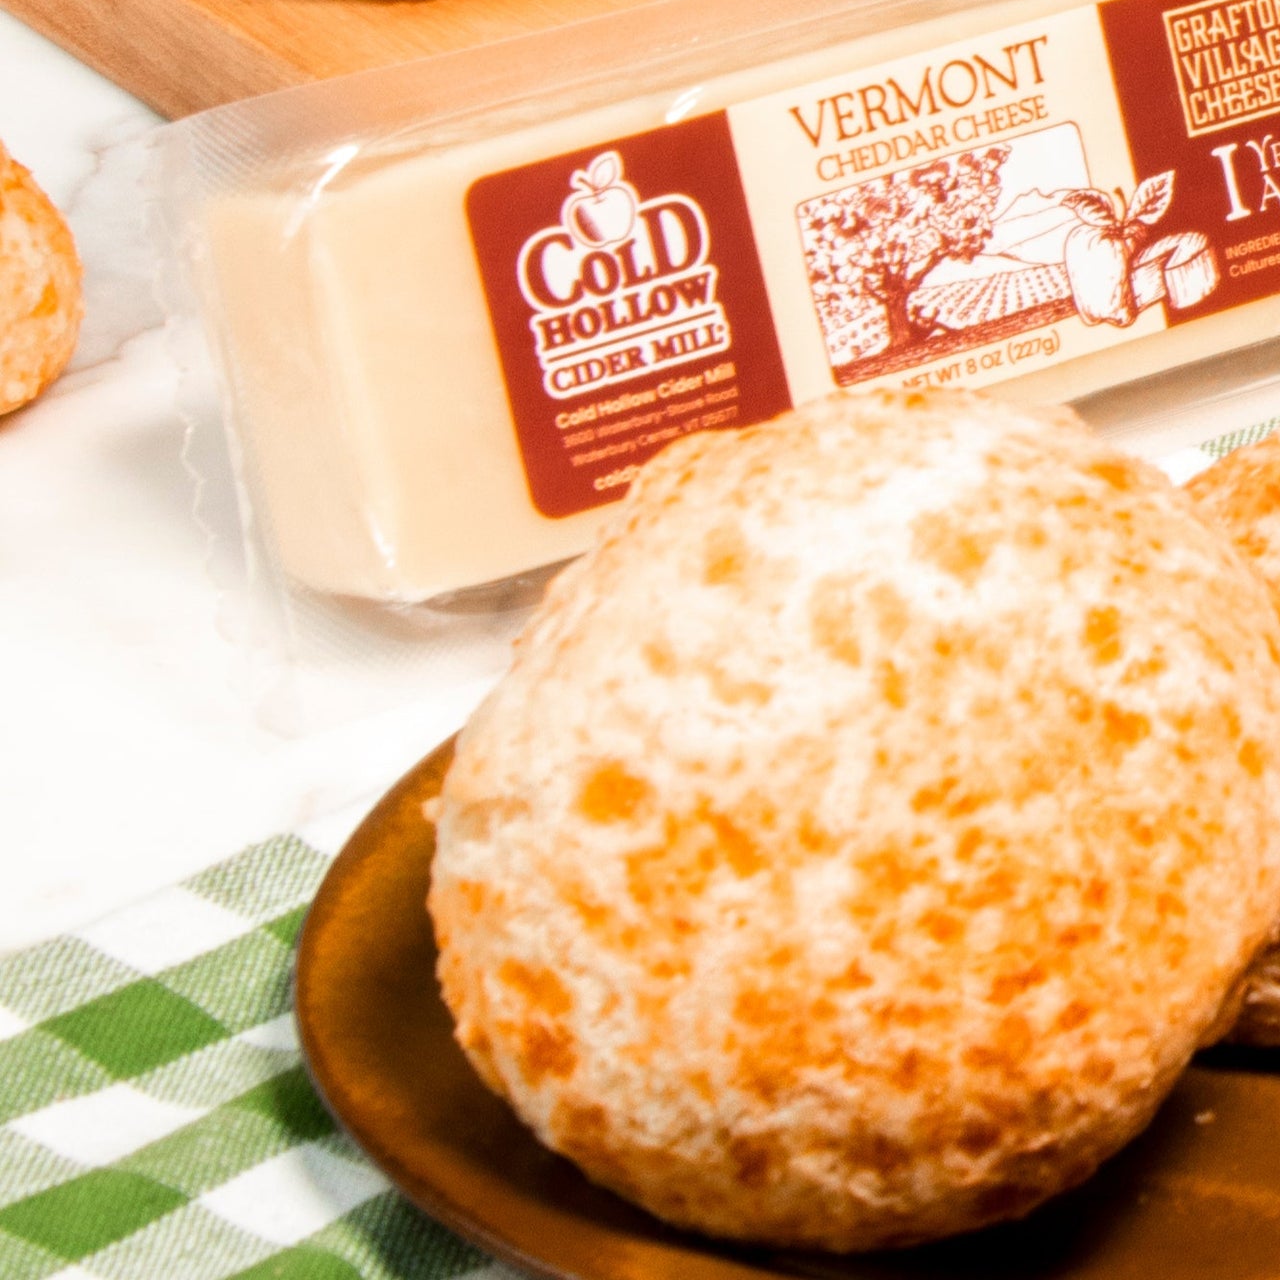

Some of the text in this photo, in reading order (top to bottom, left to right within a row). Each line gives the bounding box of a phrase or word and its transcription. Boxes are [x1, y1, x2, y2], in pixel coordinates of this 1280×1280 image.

[789, 35, 1047, 148] VERMONT
[816, 95, 1049, 183] CHEDDAR CHEESE
[525, 202, 703, 309] COLD
[536, 272, 714, 350] HOLLOW
[552, 345, 645, 390] CIDER
[903, 329, 1060, 388] NET WT 8 OZ (227g)
[556, 405, 597, 428] Cold
[597, 391, 657, 416] Hollow
[657, 376, 703, 398] Cider
